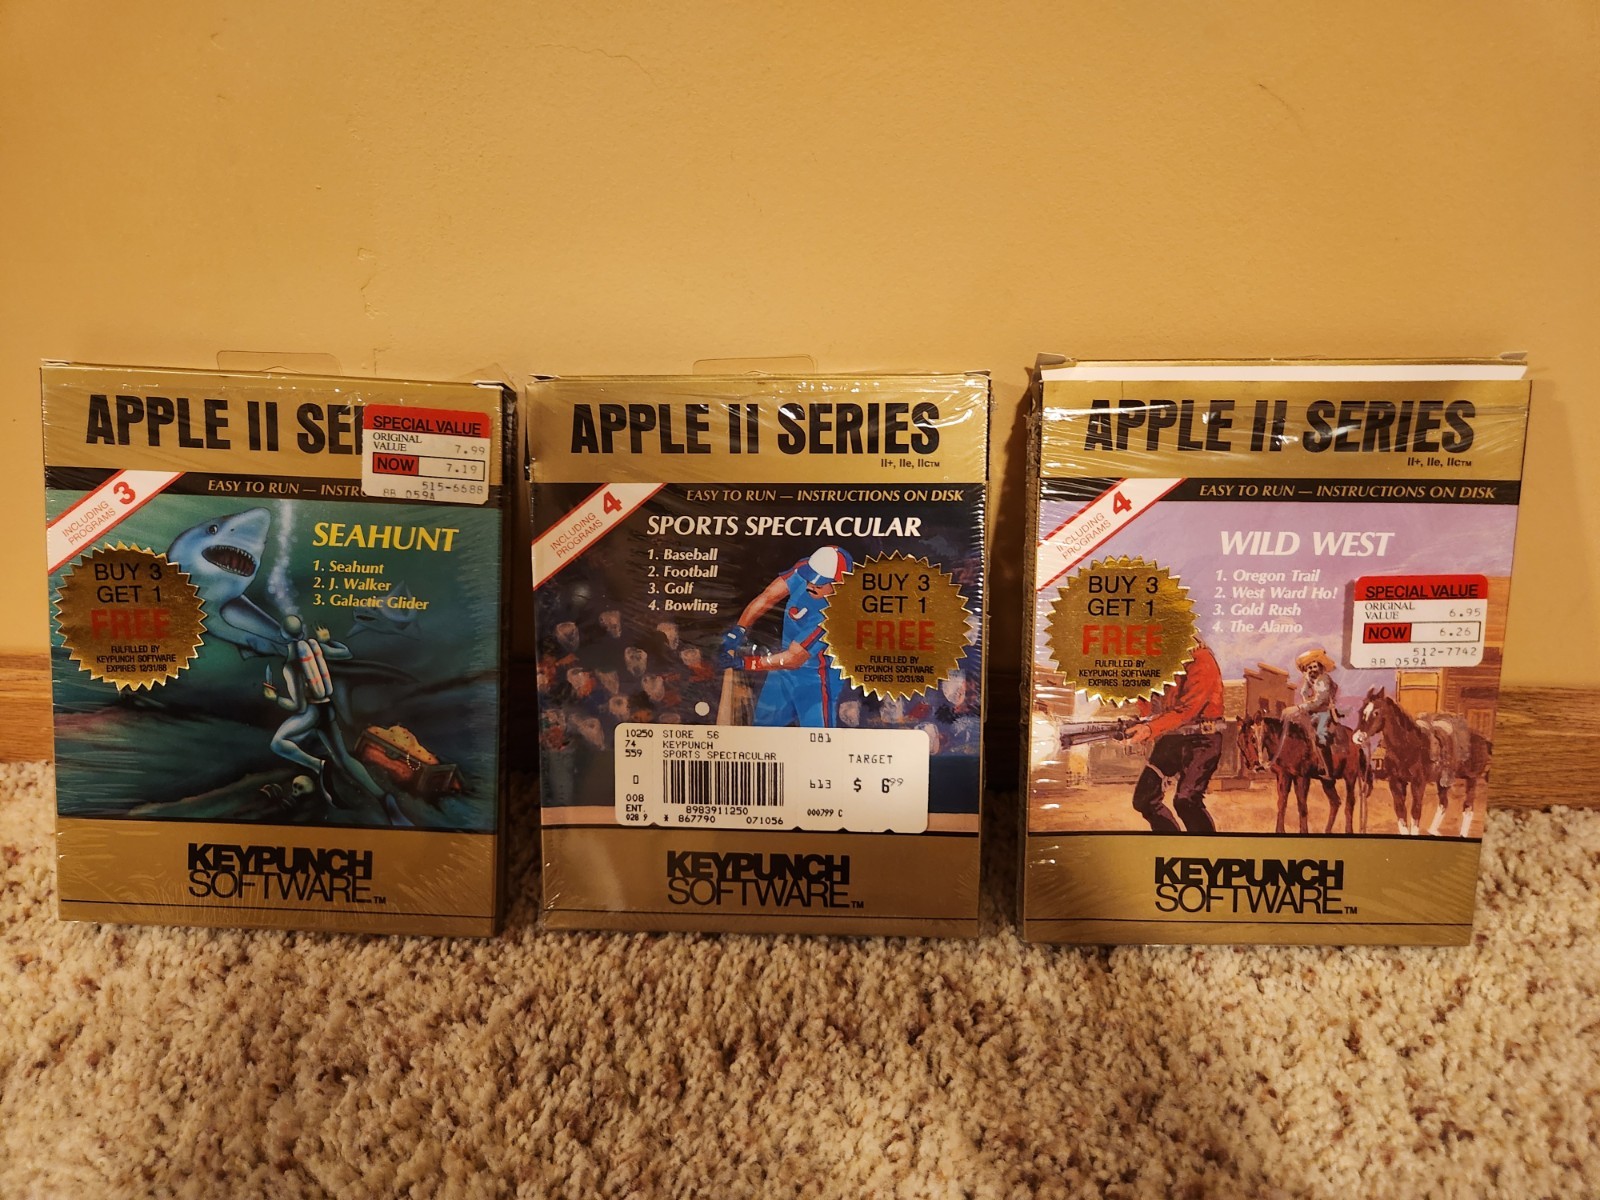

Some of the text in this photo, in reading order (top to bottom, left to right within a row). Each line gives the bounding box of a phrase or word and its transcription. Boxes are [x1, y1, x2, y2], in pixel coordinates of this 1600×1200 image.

[86, 394, 231, 450] APPLE
[248, 400, 279, 452] II
[373, 416, 481, 435] SPECIAL VALUE
[571, 402, 940, 455] APPLE II SERIES
[1084, 400, 1476, 453] APPLE II SERIES
[373, 432, 422, 443] ORIGINAL
[374, 442, 485, 455] VALUE 7.99
[378, 457, 478, 474] NOW 7.19
[113, 481, 137, 505] 3
[208, 480, 241, 491] EASY
[245, 482, 264, 492] TO
[269, 482, 300, 494] RUN
[1200, 486, 1497, 499] EASY TO RUN INSTRUCTIONS ON DISK
[687, 490, 964, 501] EASY TO RUN INSTRUCTIONS ON DISK
[603, 492, 623, 515] 4
[1113, 491, 1132, 515] 4
[62, 501, 110, 537] INCLUDING
[647, 515, 922, 537] SPORTS SPECTACULAR
[68, 508, 116, 546] PROGRAMS
[550, 513, 597, 551] INCLUDING
[312, 522, 459, 552] SEAHUNT
[556, 520, 604, 558] PROGRAMS
[1062, 520, 1111, 560] PROGRAMS
[1220, 531, 1395, 556] WILD WEST
[648, 548, 718, 561] 1. Baseball
[94, 564, 162, 581] BUY 3
[313, 560, 384, 574] 1. Seahunt
[648, 565, 718, 578] 2. Football
[862, 574, 930, 591] BUY 3
[1216, 569, 1321, 584] 1. Oregon Trail
[313, 577, 392, 591] 2. J. Walker
[648, 582, 694, 595] 3. Golf
[1089, 576, 1158, 594] BUY 3
[1365, 584, 1479, 598] SPECIAL VALUE
[97, 586, 161, 603] GET 1
[1214, 586, 1338, 599] 2. West Ward Ho!
[313, 594, 429, 610] 3. Galactic Glider
[648, 599, 718, 614] 4. Bowling
[862, 595, 926, 613] GET 1
[1088, 598, 1153, 617] GET 1
[1365, 602, 1415, 610] ORIGINAL
[1213, 604, 1302, 616] 3. Gold Rush
[1365, 608, 1480, 620] VALUE 6.95
[90, 609, 170, 640] FREE
[1212, 620, 1303, 633] 4. The Alamo
[856, 620, 936, 651] FREE
[1082, 625, 1163, 656] FREE
[1368, 627, 1471, 640] NOW 6.26
[111, 646, 147, 654] FULFILLED
[1413, 647, 1477, 656] 512-7742
[138, 654, 176, 662] SOFTWARE
[870, 656, 919, 664] FULFILLED BY
[855, 665, 934, 674] KEYPUNCH SOFTWARE
[1121, 670, 1160, 678] SOFTWARE
[1089, 679, 1118, 687] EXPIRES
[626, 730, 653, 738] 10250
[663, 730, 831, 742] STORE 56 081
[663, 741, 713, 750] KEYPUNCH
[625, 749, 642, 758] 559
[663, 750, 777, 760] SPORTS SPECTACULAR
[849, 754, 893, 764] TARGET
[810, 779, 831, 789] 613
[626, 794, 644, 802] 008
[686, 806, 748, 815] 8983911250
[678, 815, 783, 825] 867790 071056
[188, 843, 373, 880] KEYPUNCH
[667, 851, 850, 885] KEYPUNCH
[1155, 857, 1344, 890] KEYPUNCH
[189, 870, 372, 904] SOFTWARE
[668, 877, 850, 908] SOFTWARE
[1155, 884, 1343, 914] SOFTWARE
